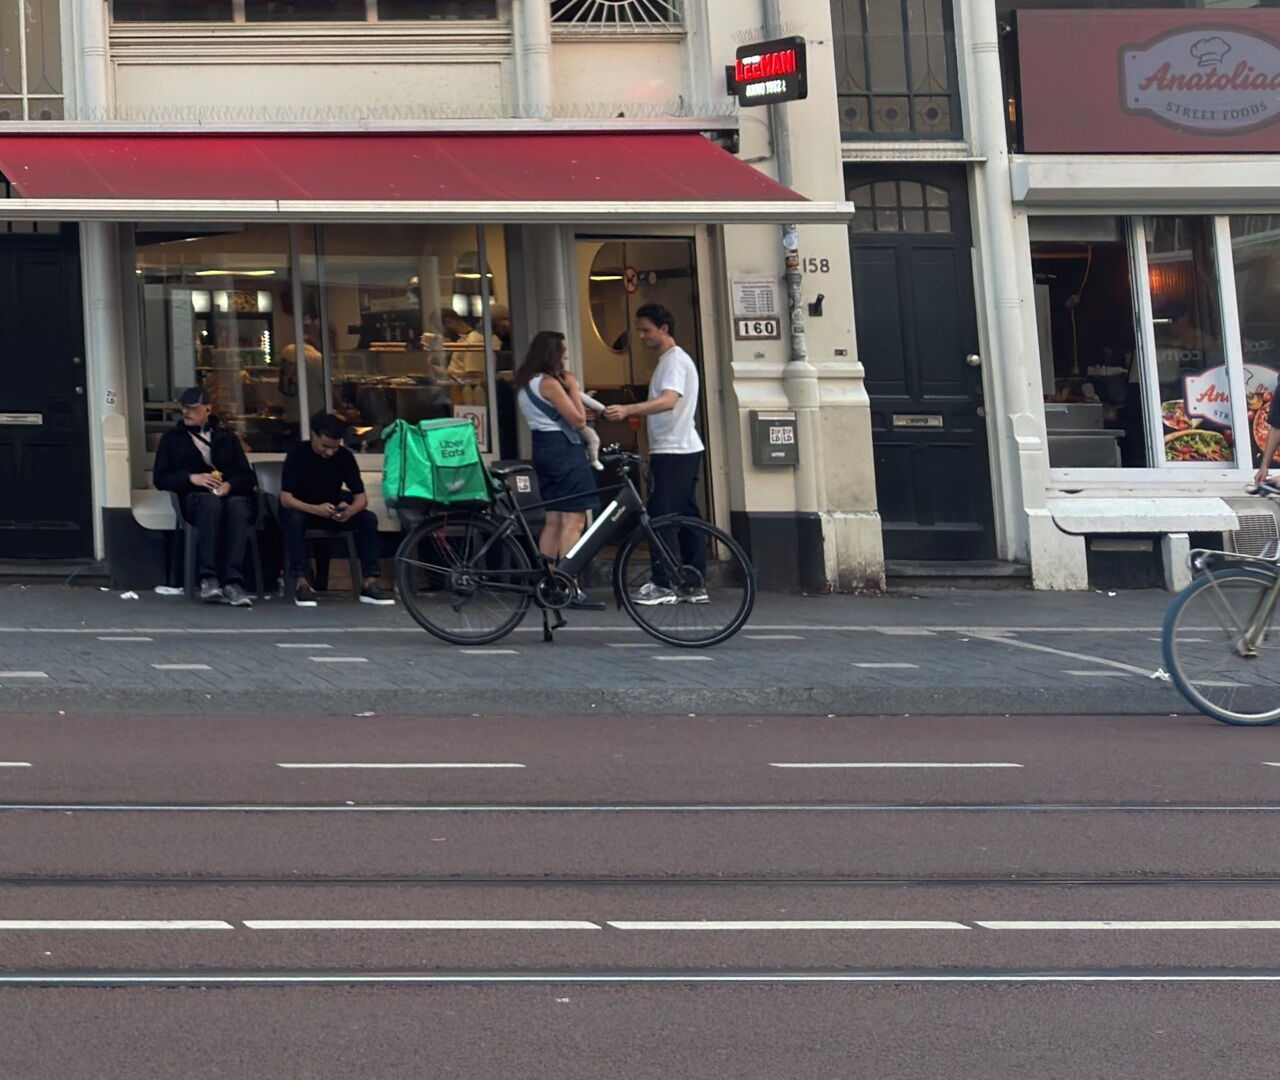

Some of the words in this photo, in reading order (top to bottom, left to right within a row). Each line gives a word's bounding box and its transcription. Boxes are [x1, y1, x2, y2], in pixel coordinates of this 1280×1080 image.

[735, 49, 797, 83] LEEMAN
[1166, 101, 1215, 121] STREET
[1223, 100, 1268, 121] FOODS
[803, 258, 830, 273] 158
[744, 321, 774, 335] 160
[440, 440, 464, 449] Uber
[441, 449, 466, 459] Eats
